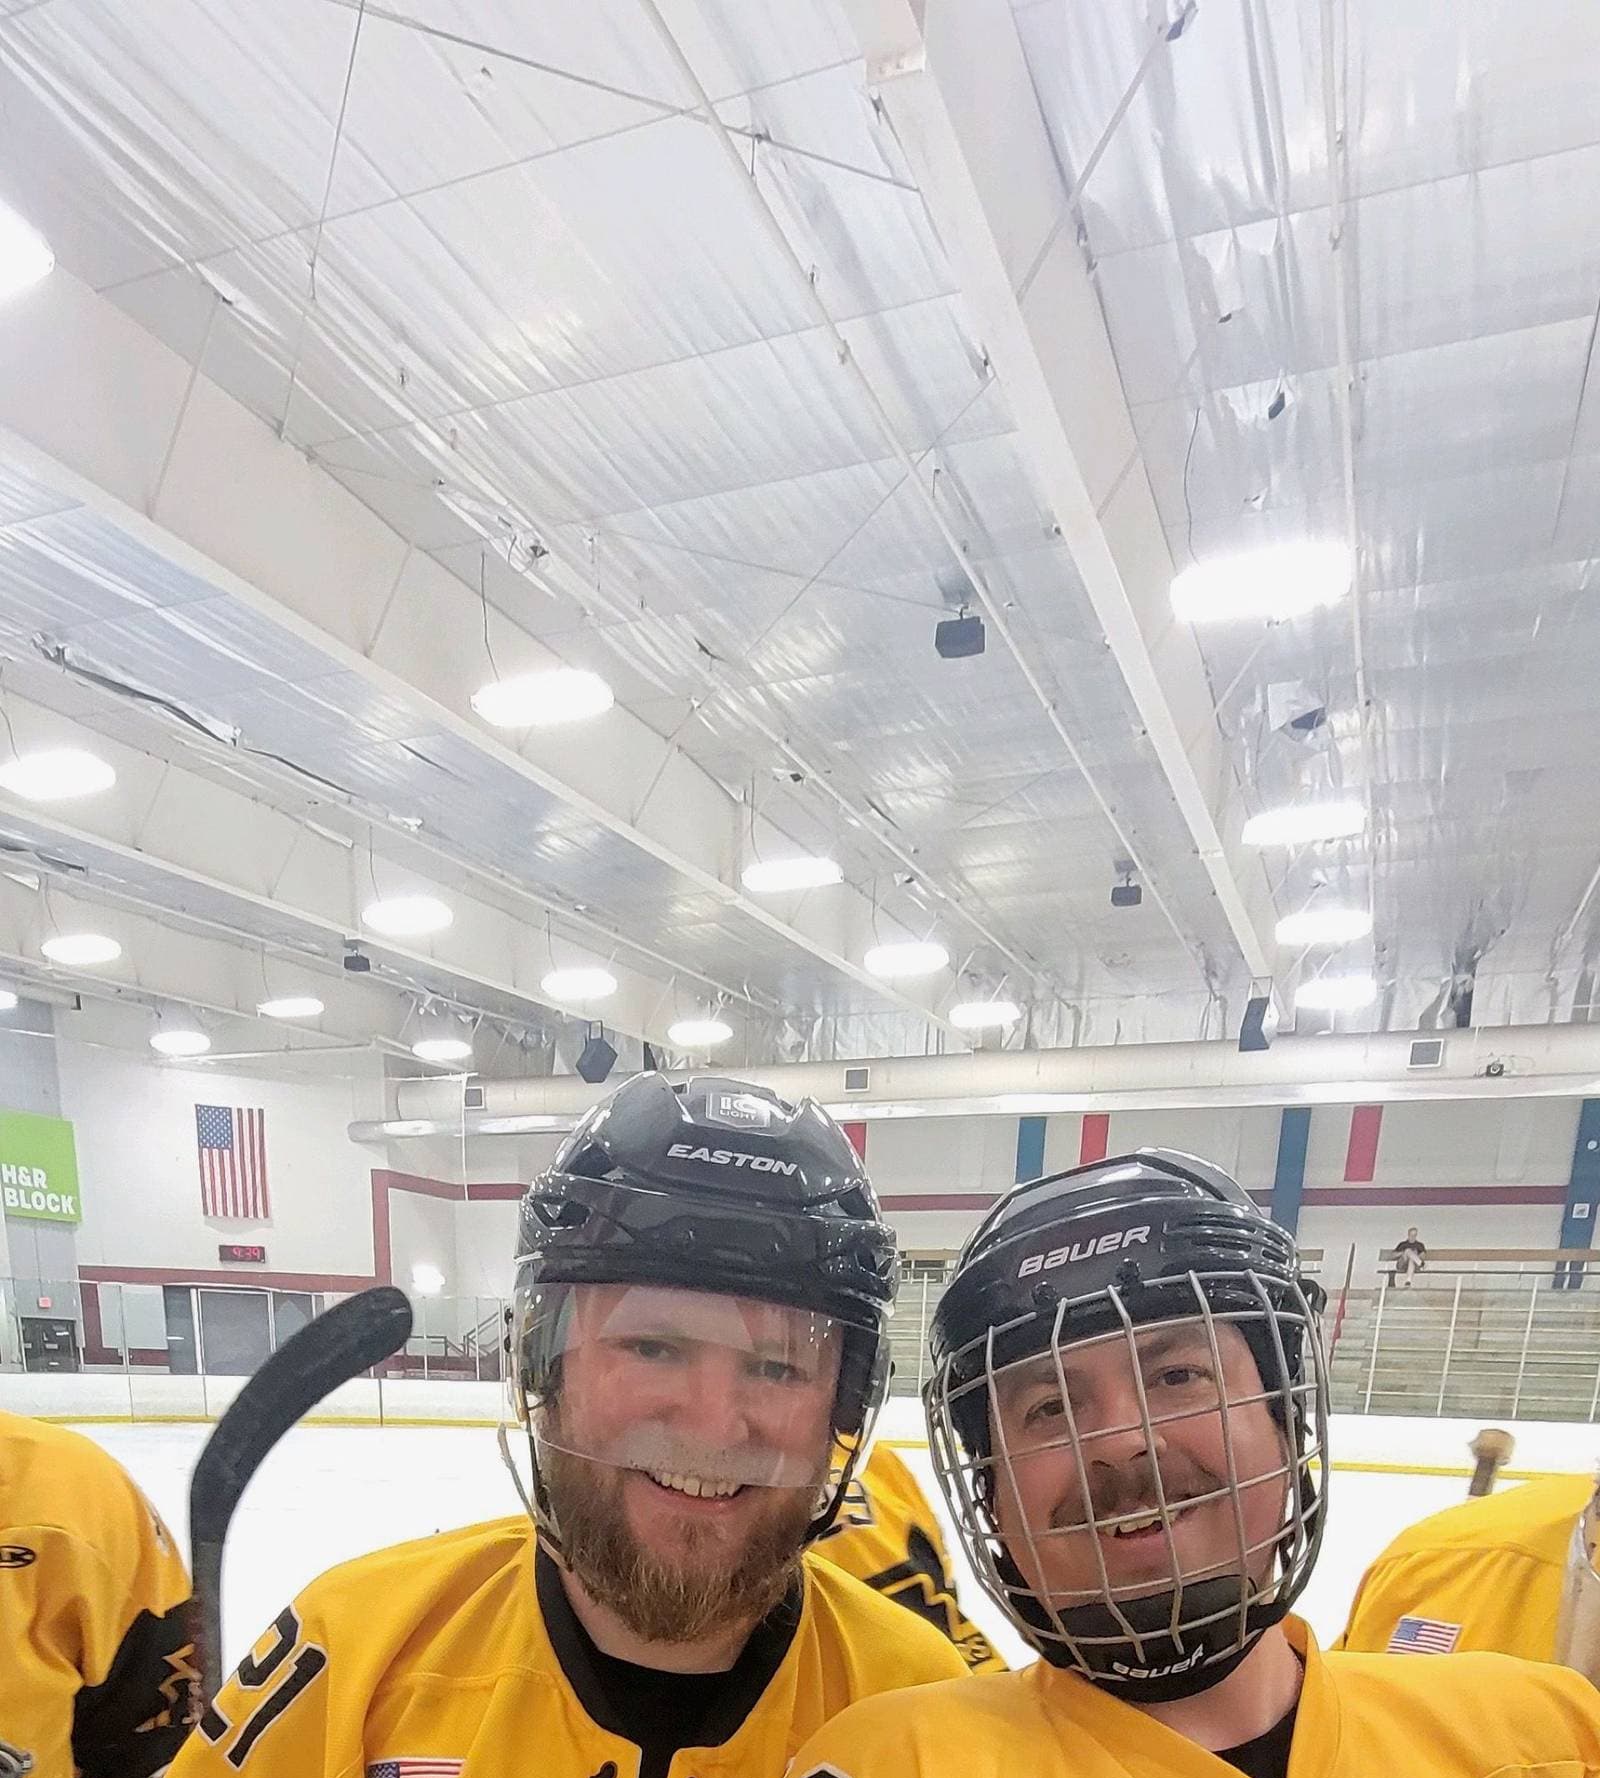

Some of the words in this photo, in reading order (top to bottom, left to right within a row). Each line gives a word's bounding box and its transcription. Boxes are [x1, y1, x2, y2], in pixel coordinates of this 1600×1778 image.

[1, 1163, 48, 1189] H&R
[667, 1143, 798, 1176] EASTON
[4, 1187, 76, 1215] BLOCK
[1018, 1225, 1151, 1278] BAUER
[1112, 1643, 1204, 1679] BAUER
[197, 1602, 330, 1773] 21
